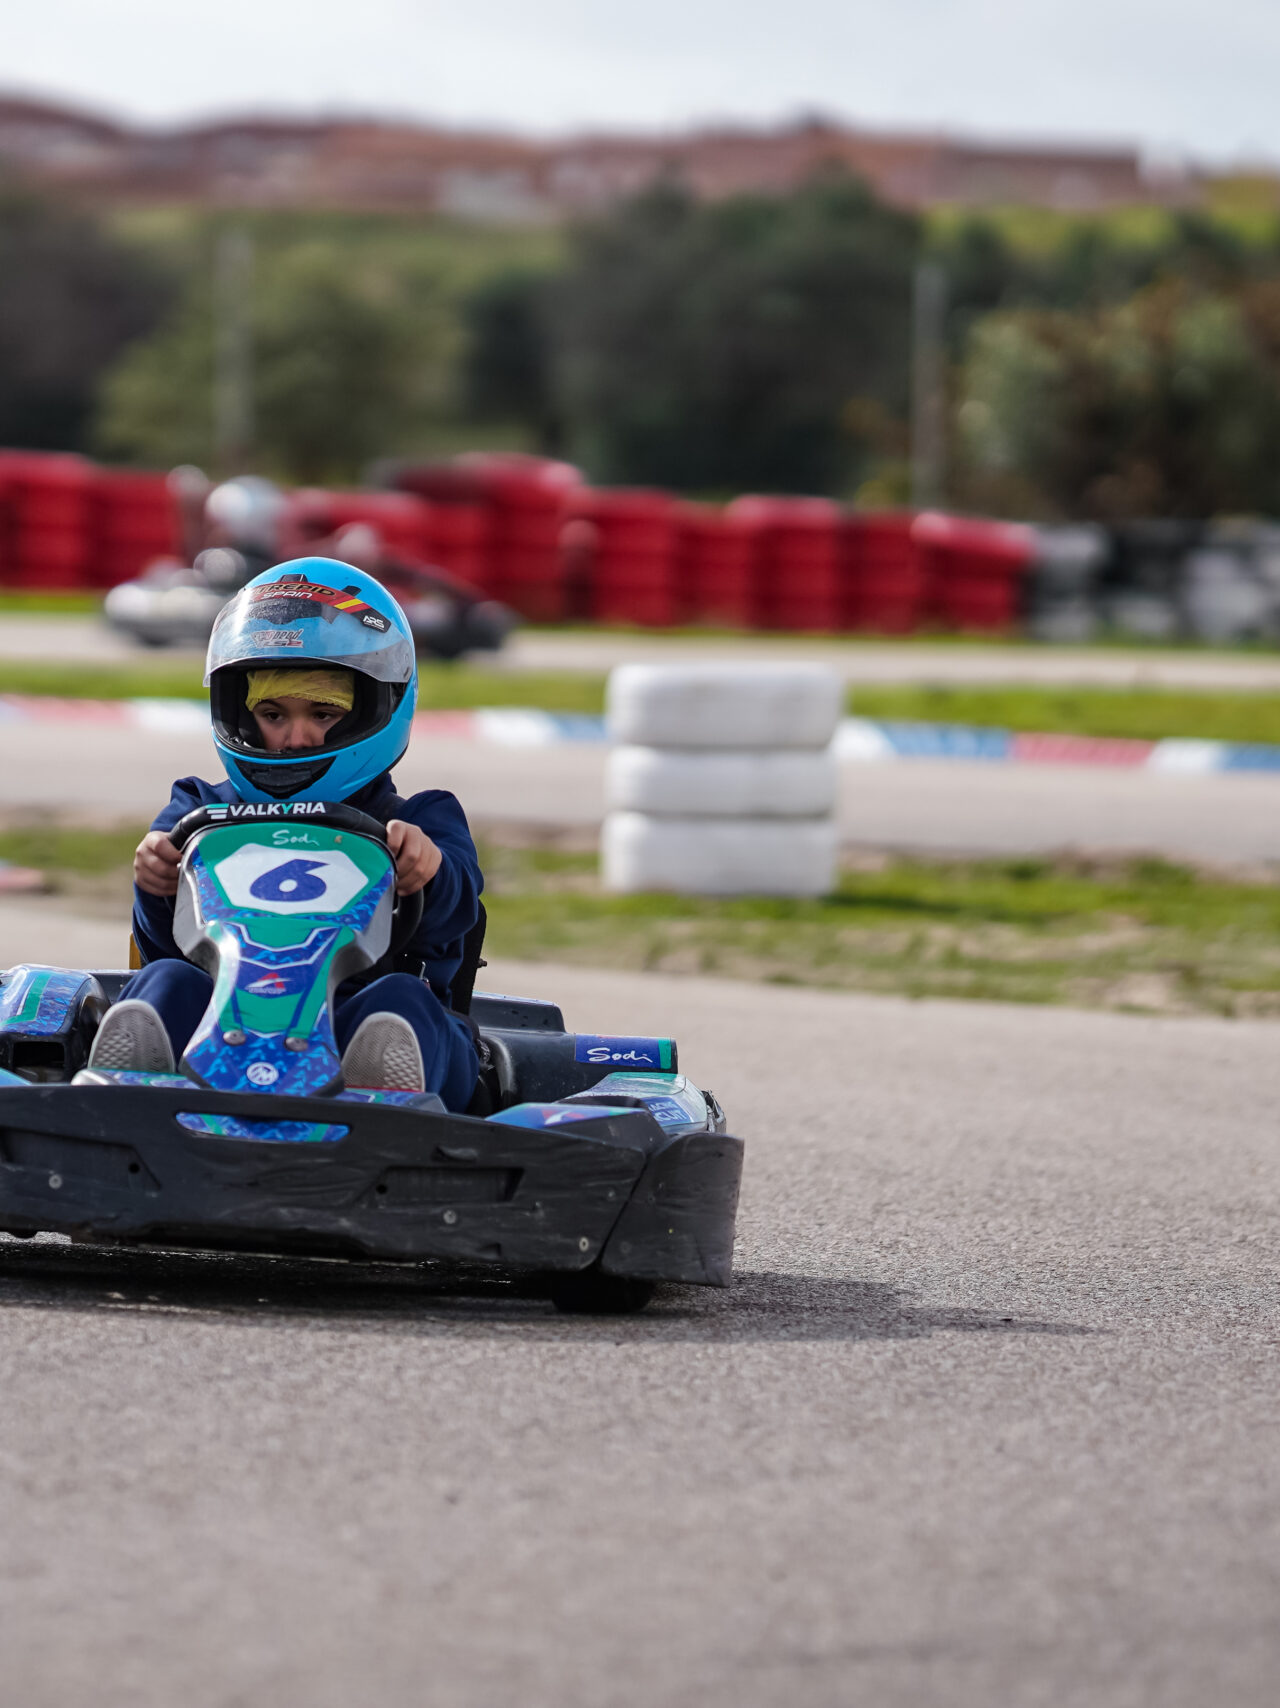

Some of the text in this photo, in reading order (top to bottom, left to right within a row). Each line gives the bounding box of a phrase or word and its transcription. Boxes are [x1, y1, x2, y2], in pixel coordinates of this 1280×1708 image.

[253, 583, 336, 596] TREPID
[261, 590, 313, 600] SPAIN
[230, 801, 326, 817] VALKYRIA
[249, 858, 330, 902] 6
[586, 1046, 654, 1063] Sodi
